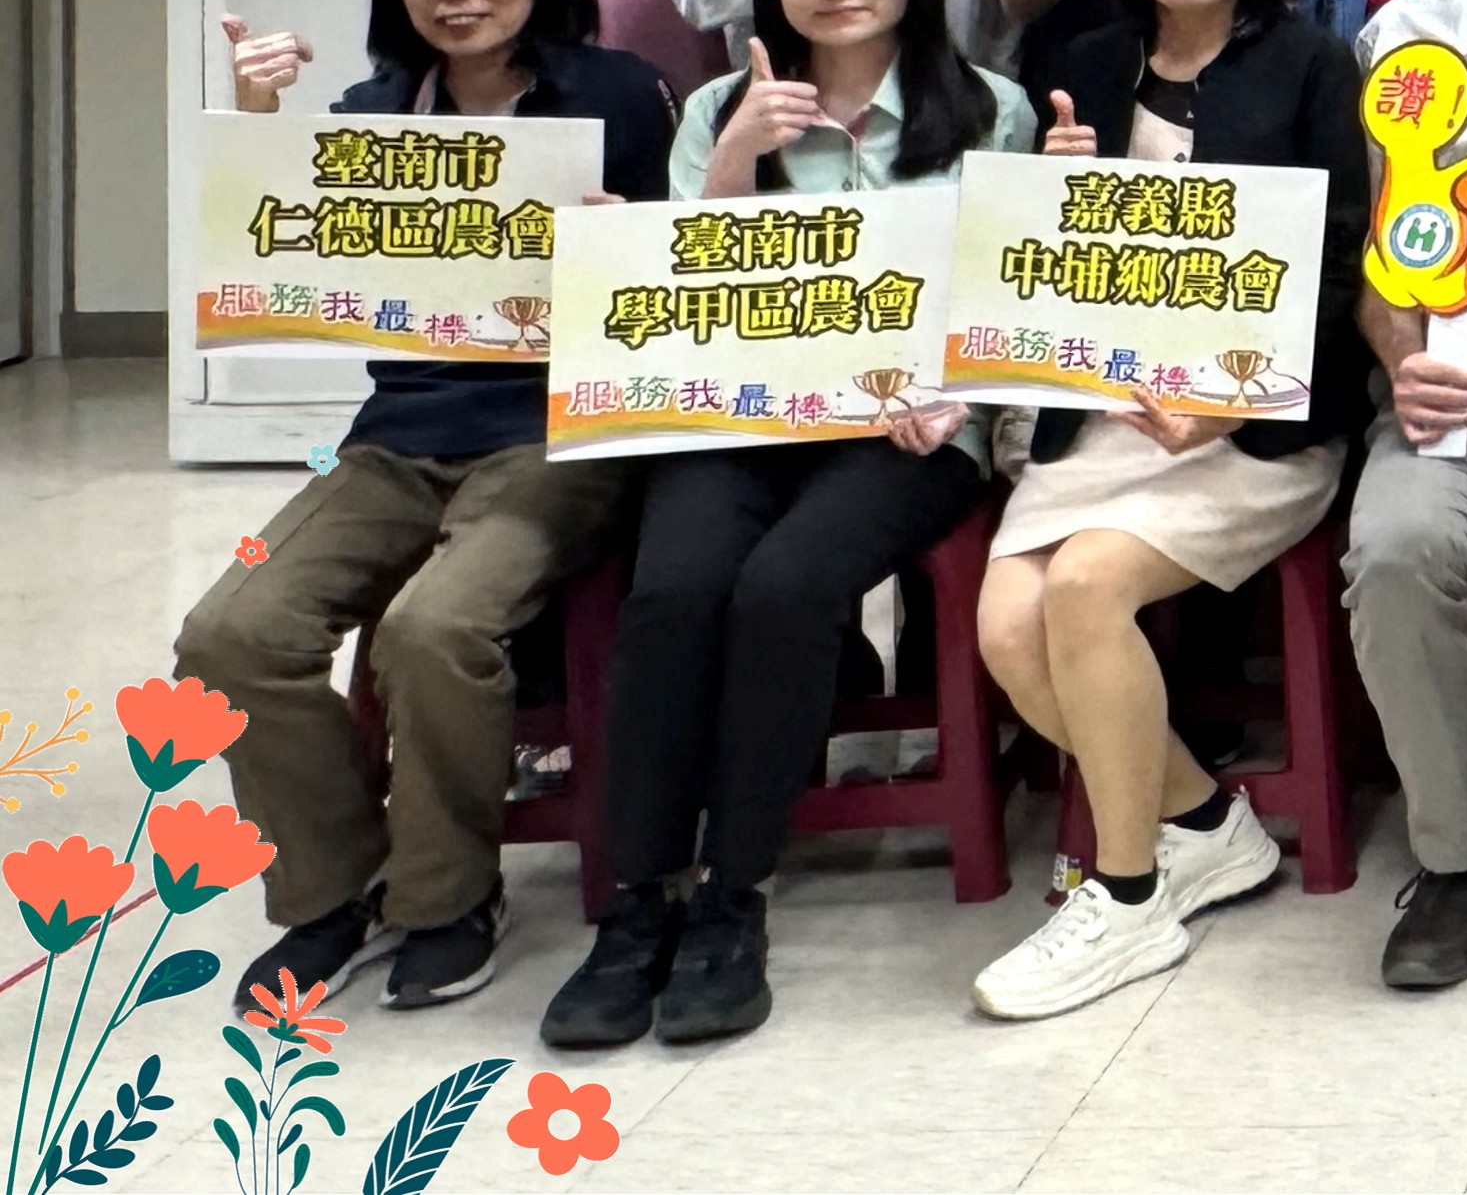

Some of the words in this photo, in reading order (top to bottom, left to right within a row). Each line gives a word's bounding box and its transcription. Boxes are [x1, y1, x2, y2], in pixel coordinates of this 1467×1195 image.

[312, 128, 506, 191] 臺南市
[248, 196, 555, 260] 仁德區農會
[1059, 171, 1236, 238] 嘉義縣
[671, 207, 863, 274] 臺南市
[1001, 238, 1289, 313] 中埔鄉農會
[604, 271, 924, 350] 學甲區農會
